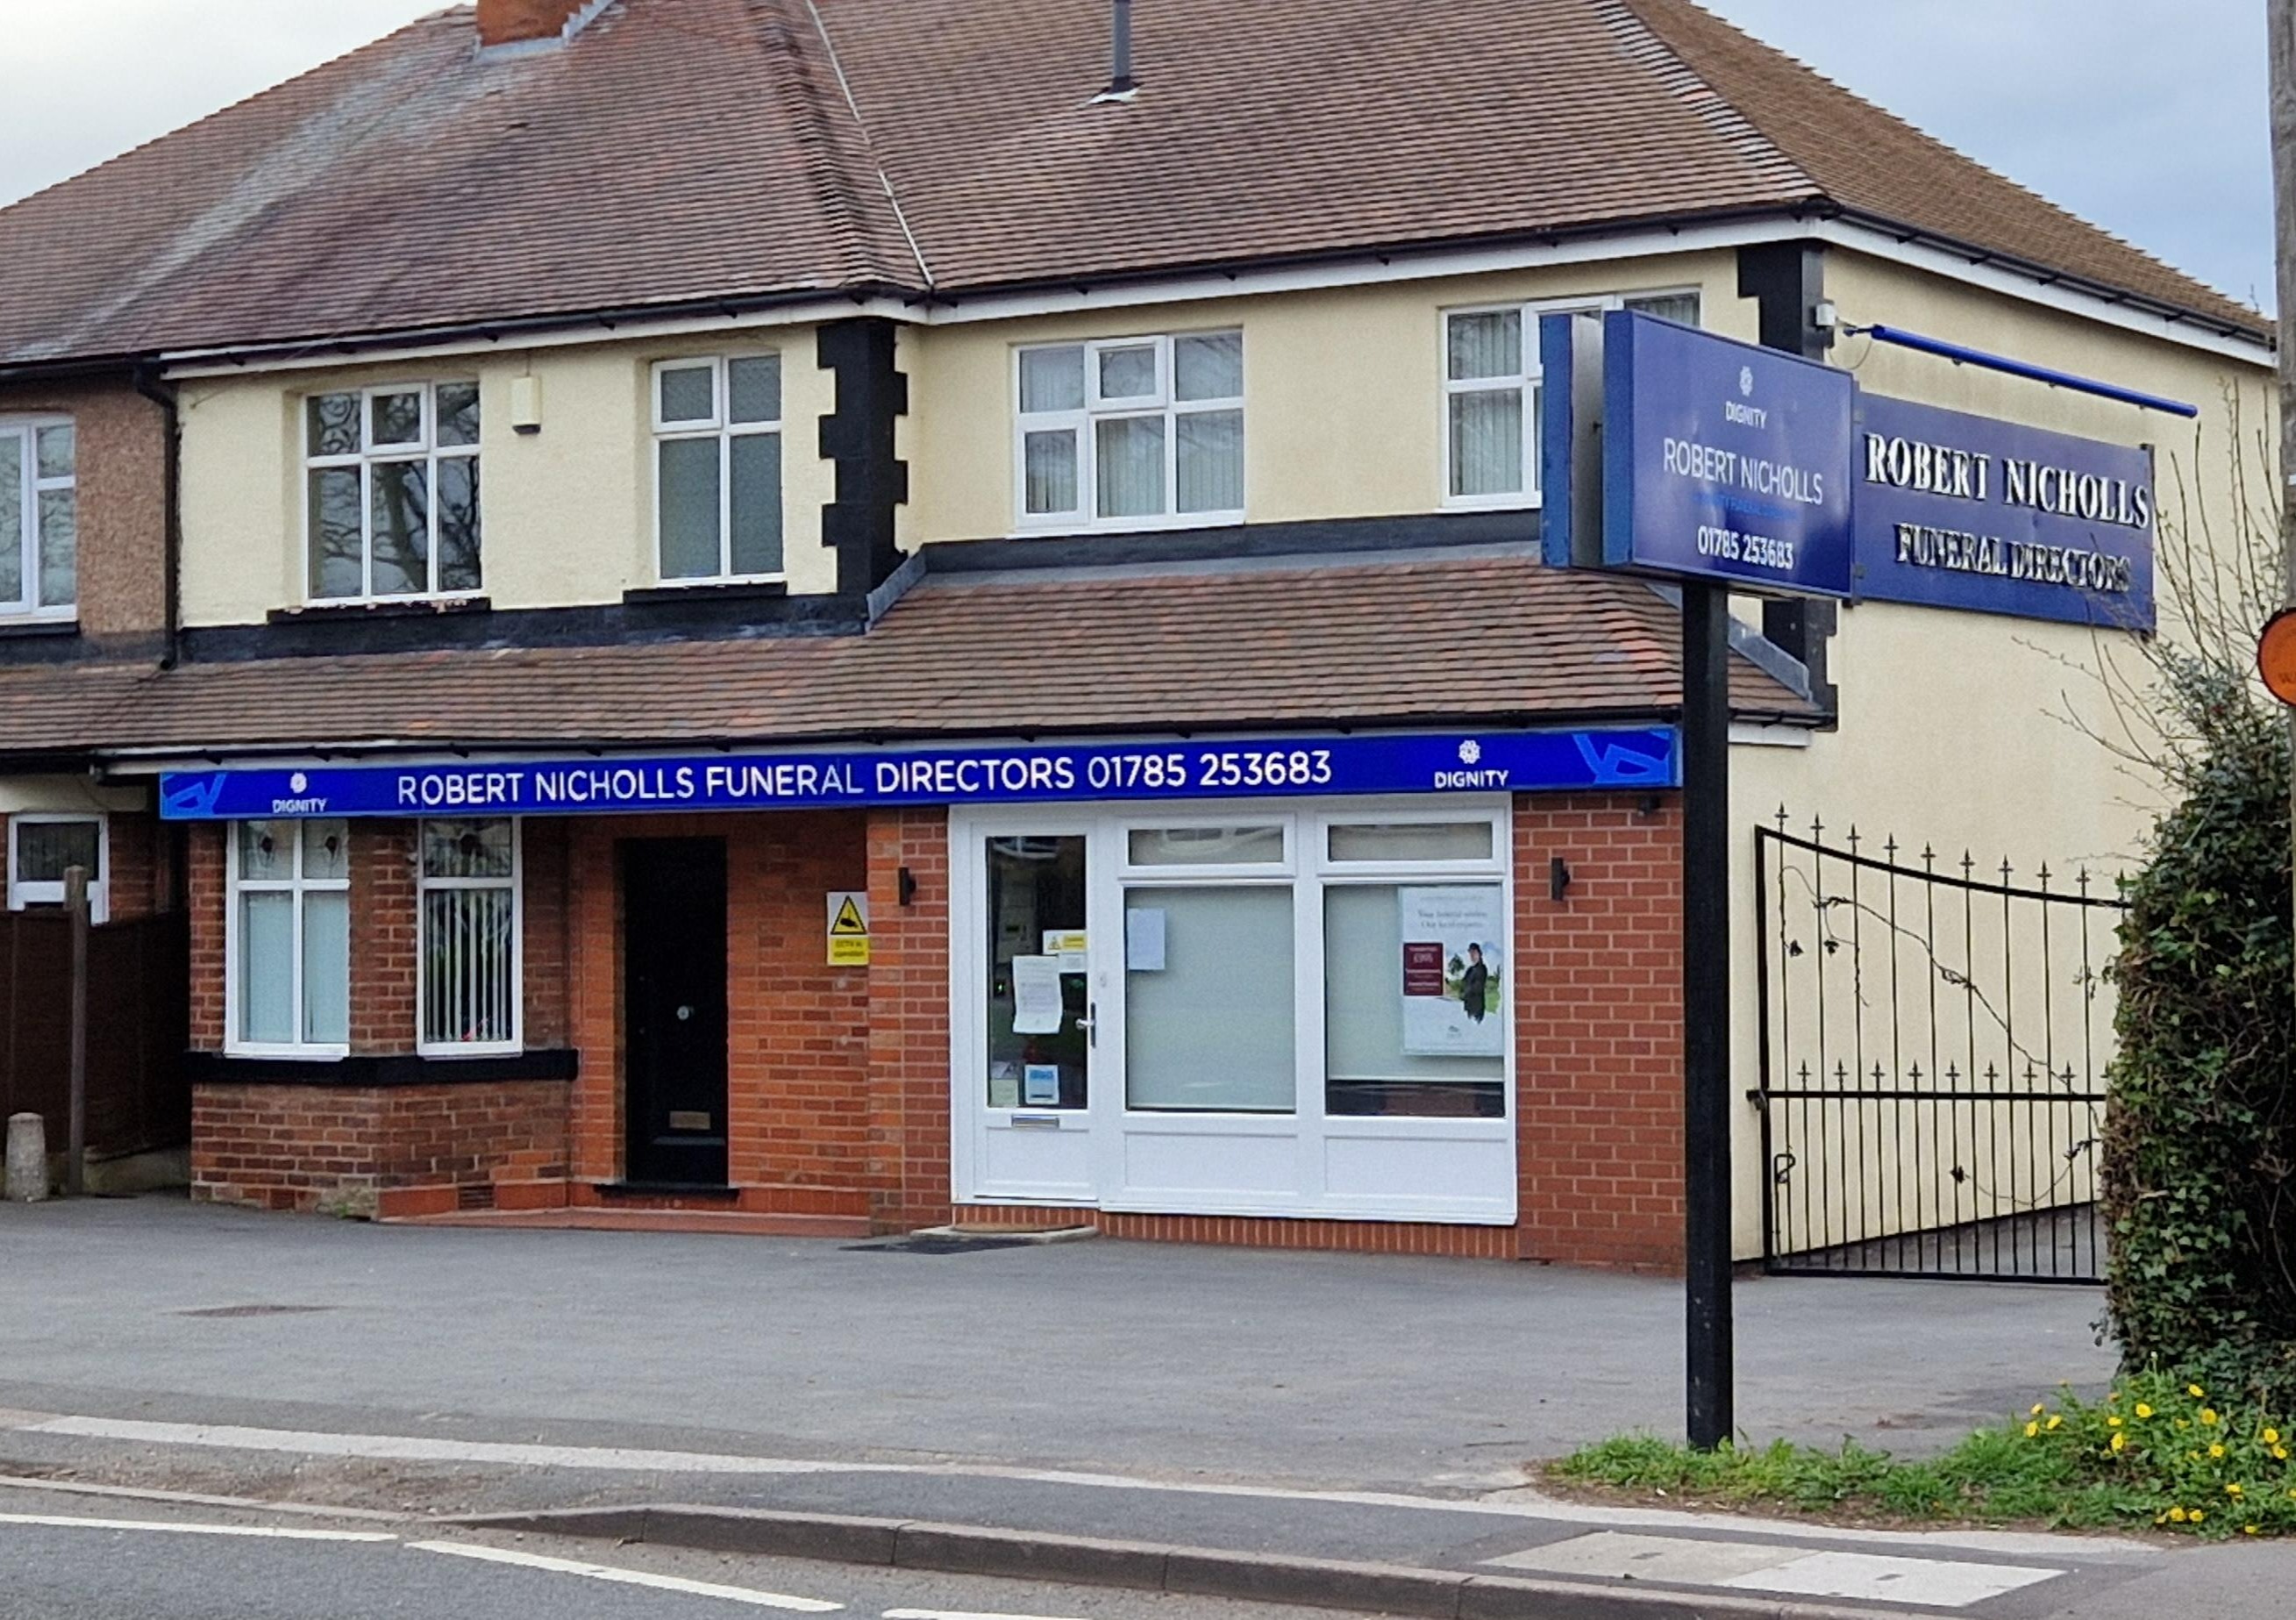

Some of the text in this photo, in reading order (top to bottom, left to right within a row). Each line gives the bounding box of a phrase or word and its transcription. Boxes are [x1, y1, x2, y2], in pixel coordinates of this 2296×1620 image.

[1725, 401, 1767, 429] DIGNITY
[1663, 438, 1823, 505] ROBERT NICHOLLS
[1865, 432, 2150, 529] ROBERT NICHOLLS
[1697, 525, 1793, 569] 01785 253683
[1895, 523, 2131, 592] FUNERAL DIRECTORS
[397, 750, 1332, 805] ROBERT NICHOLLS FUNERAL DIRECTORS 01785 253683
[1433, 769, 1508, 789] DIGNITY
[272, 797, 327, 813] DIGNITY
